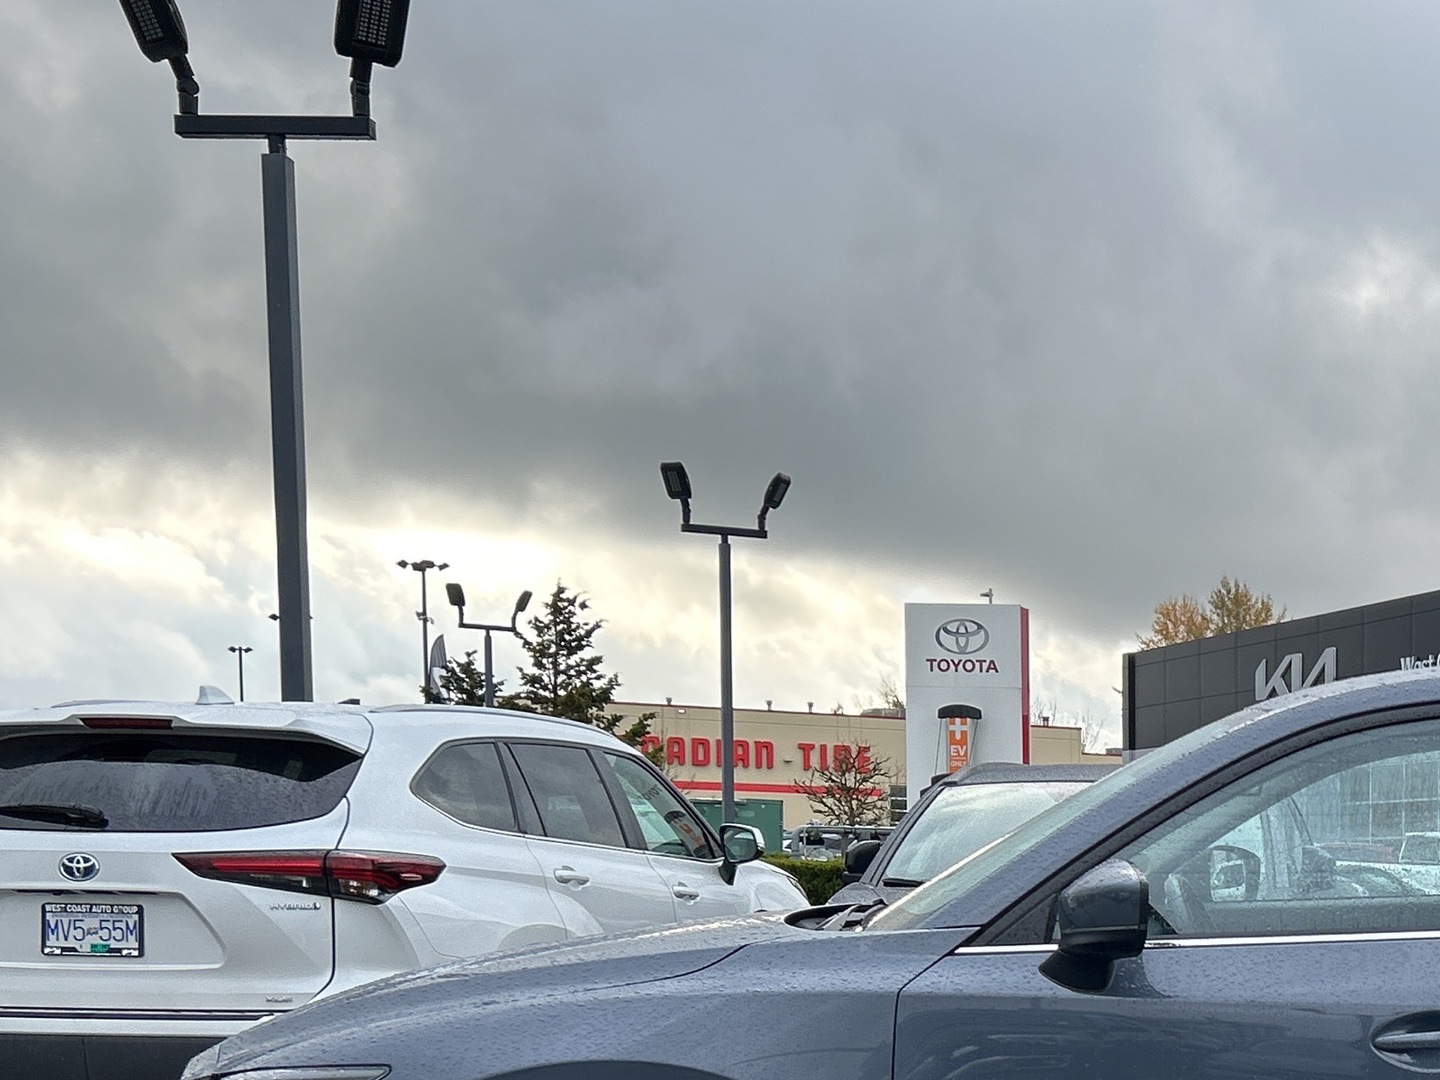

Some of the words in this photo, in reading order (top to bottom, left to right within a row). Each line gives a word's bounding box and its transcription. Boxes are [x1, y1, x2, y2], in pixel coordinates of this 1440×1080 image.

[925, 658, 999, 673] TOYOTA
[1254, 647, 1337, 700] KIA
[798, 743, 871, 774] TIRE
[950, 744, 967, 756] EV
[66, 904, 91, 913] COAST
[91, 905, 112, 913] AUTO
[46, 918, 86, 942] MV5
[98, 918, 139, 943] 55M
